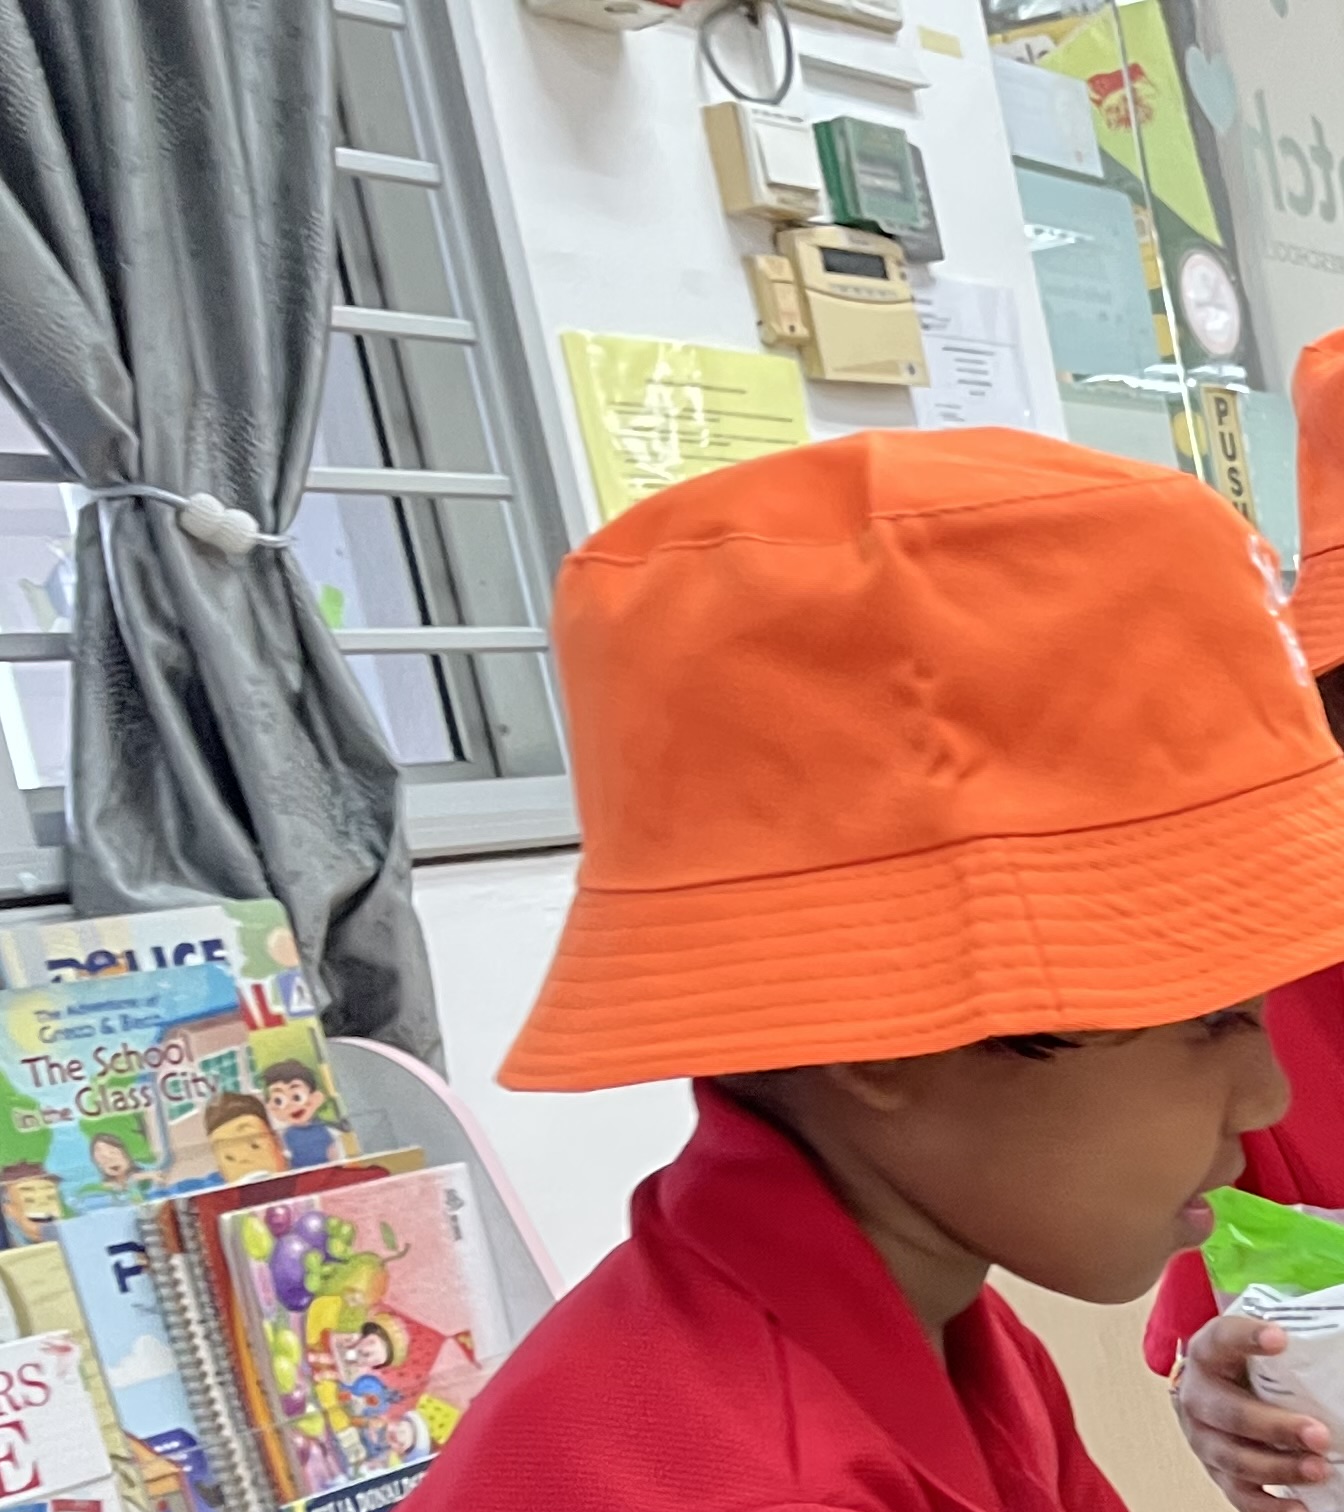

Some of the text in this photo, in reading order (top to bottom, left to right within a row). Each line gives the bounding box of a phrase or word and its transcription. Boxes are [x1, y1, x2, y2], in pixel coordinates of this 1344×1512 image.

[21, 1029, 195, 1089] The School
[75, 1086, 152, 1118] Glass
[160, 1071, 220, 1102] City
